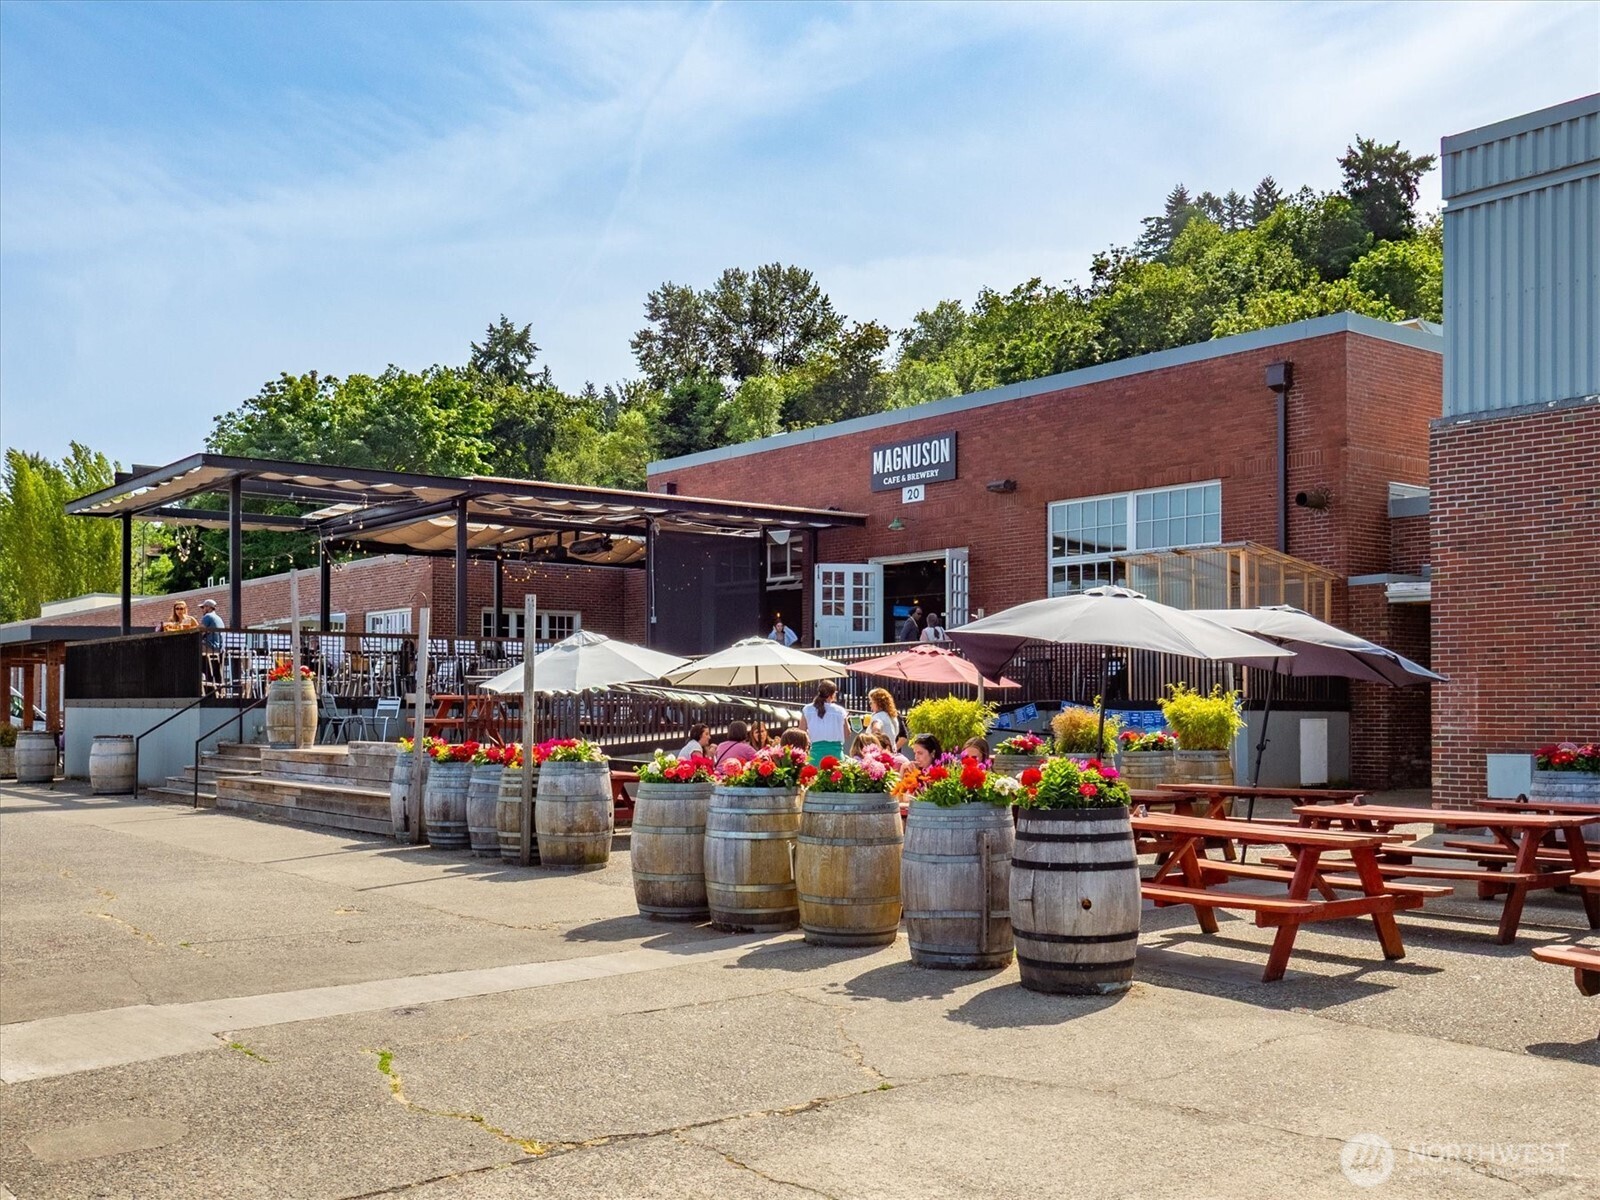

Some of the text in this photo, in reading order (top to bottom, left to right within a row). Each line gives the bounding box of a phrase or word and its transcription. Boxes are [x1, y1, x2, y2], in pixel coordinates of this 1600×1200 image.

[873, 438, 950, 475] MAGNUSON
[883, 469, 939, 485] CAFE & BREWERY
[907, 488, 920, 500] 20
